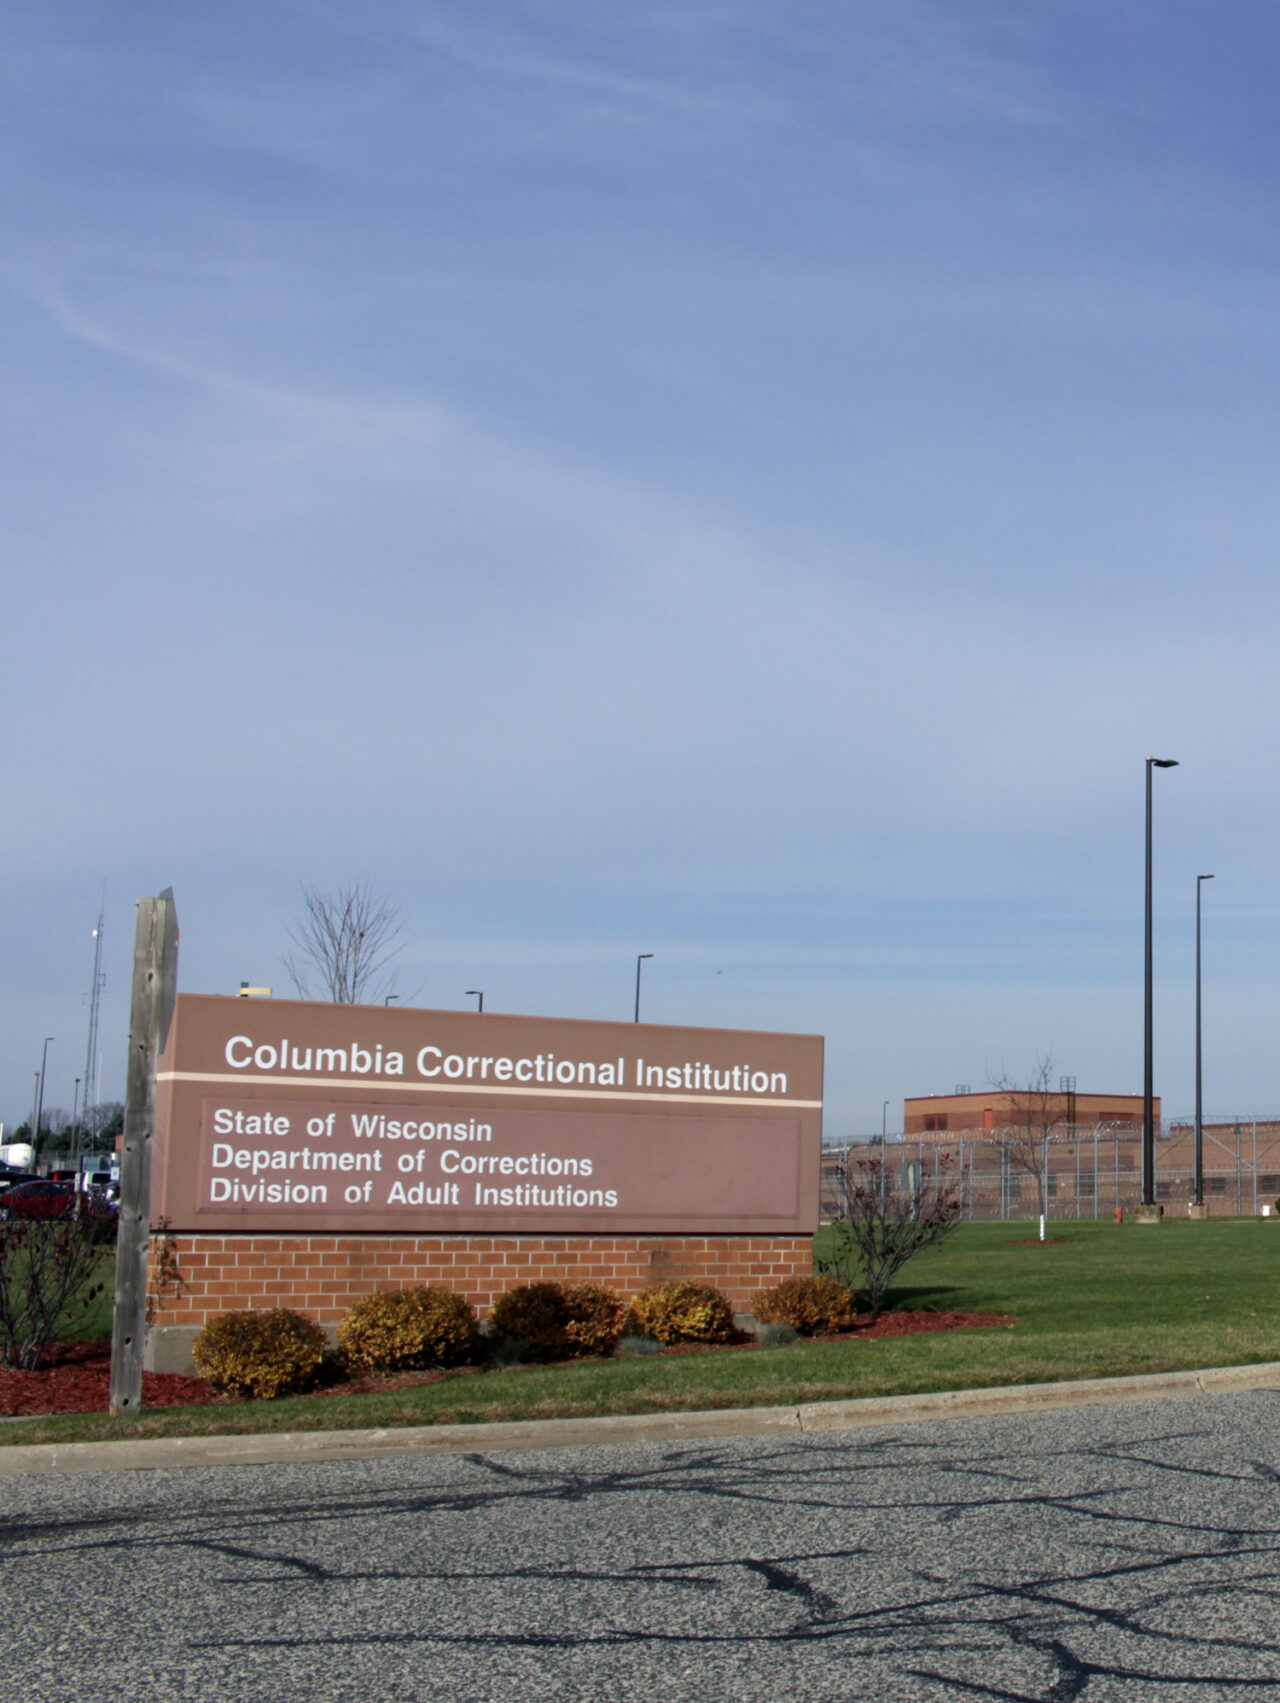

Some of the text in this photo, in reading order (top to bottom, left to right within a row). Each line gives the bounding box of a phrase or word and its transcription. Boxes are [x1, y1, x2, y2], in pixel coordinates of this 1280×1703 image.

[225, 1035, 787, 1093] Columbia Correctional Institution
[213, 1108, 492, 1142] State of Wisconsin
[212, 1143, 593, 1177] Department of Corrections
[210, 1177, 618, 1208] Division of Adult Institutions
